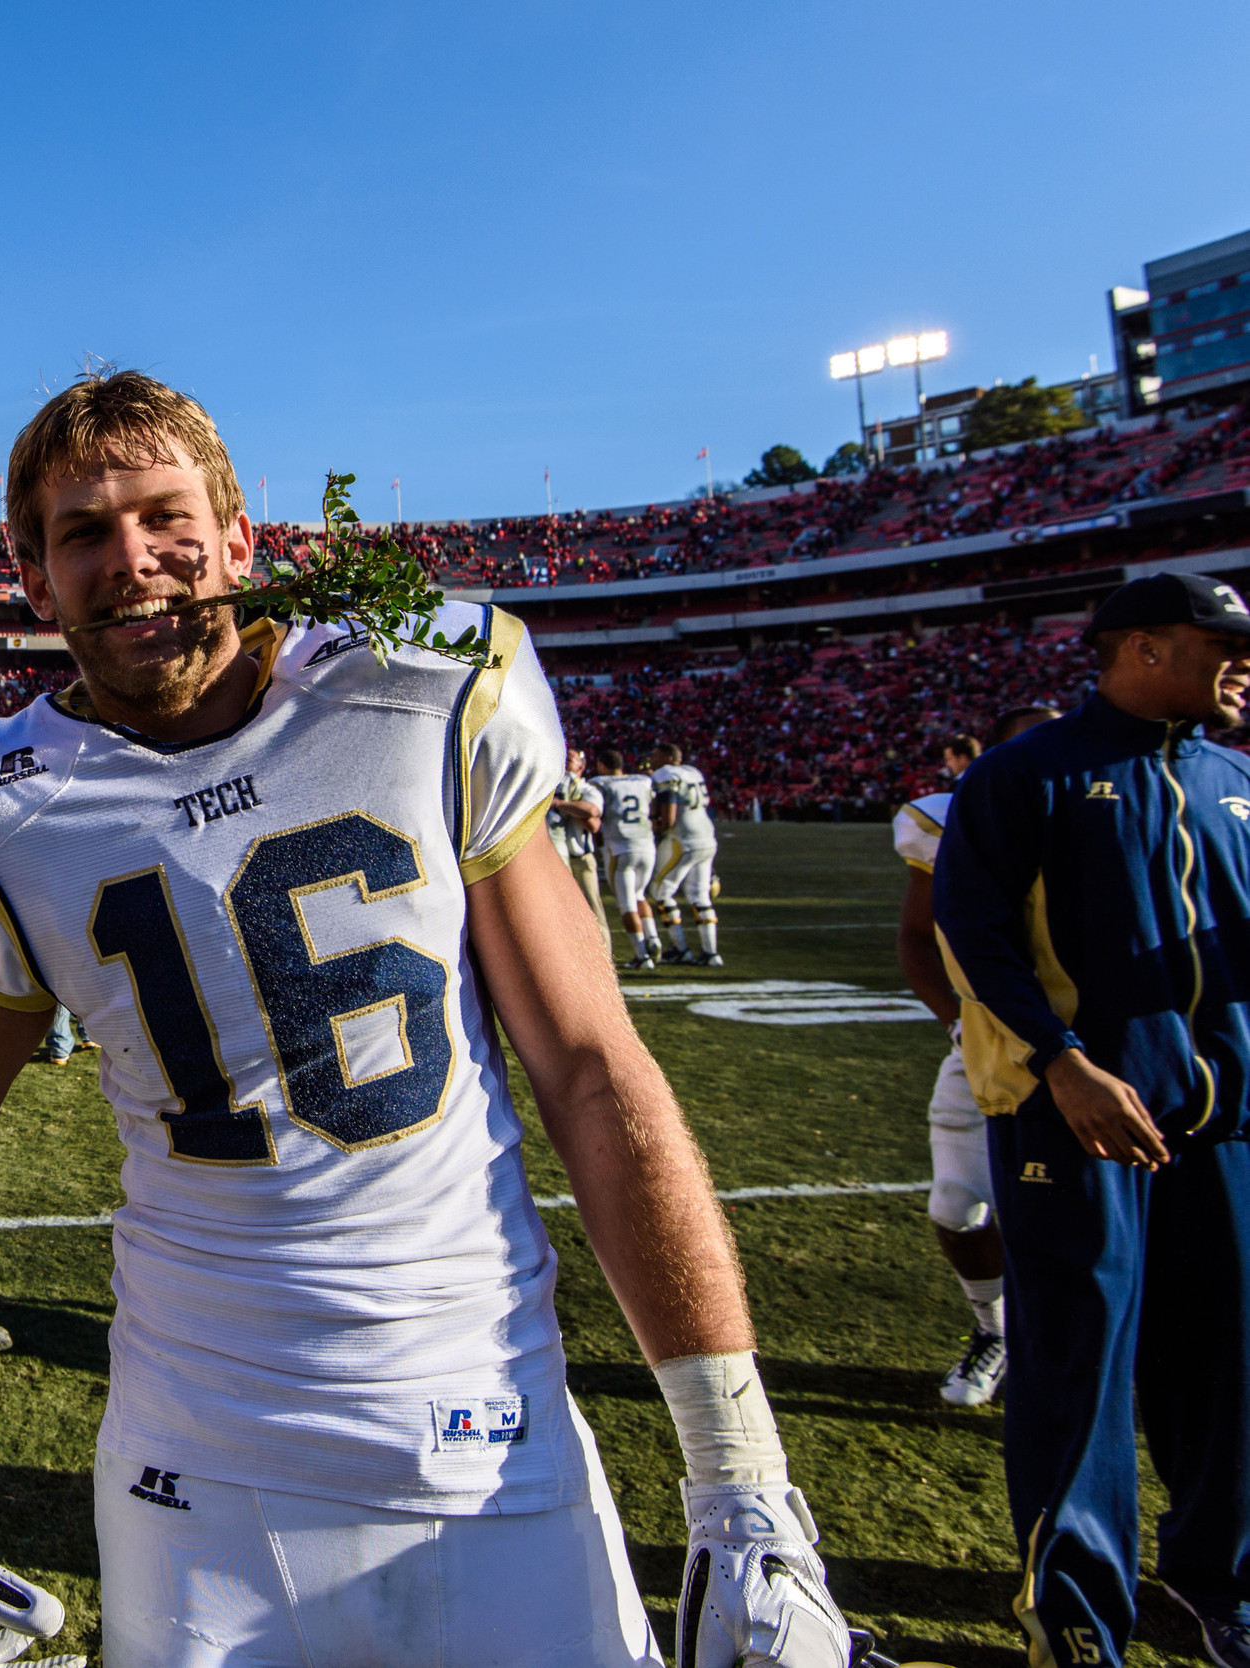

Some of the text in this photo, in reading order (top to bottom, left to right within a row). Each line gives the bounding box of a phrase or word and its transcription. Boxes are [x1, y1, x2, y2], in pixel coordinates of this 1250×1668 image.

[0, 746, 34, 776] R
[173, 774, 264, 827] TECH
[622, 795, 641, 824] 2
[87, 809, 456, 1166] 16
[442, 1428, 481, 1437] RUSSELL
[501, 1411, 516, 1426] M
[129, 1484, 191, 1511] RUSSELL
[1062, 1626, 1101, 1664] 15
